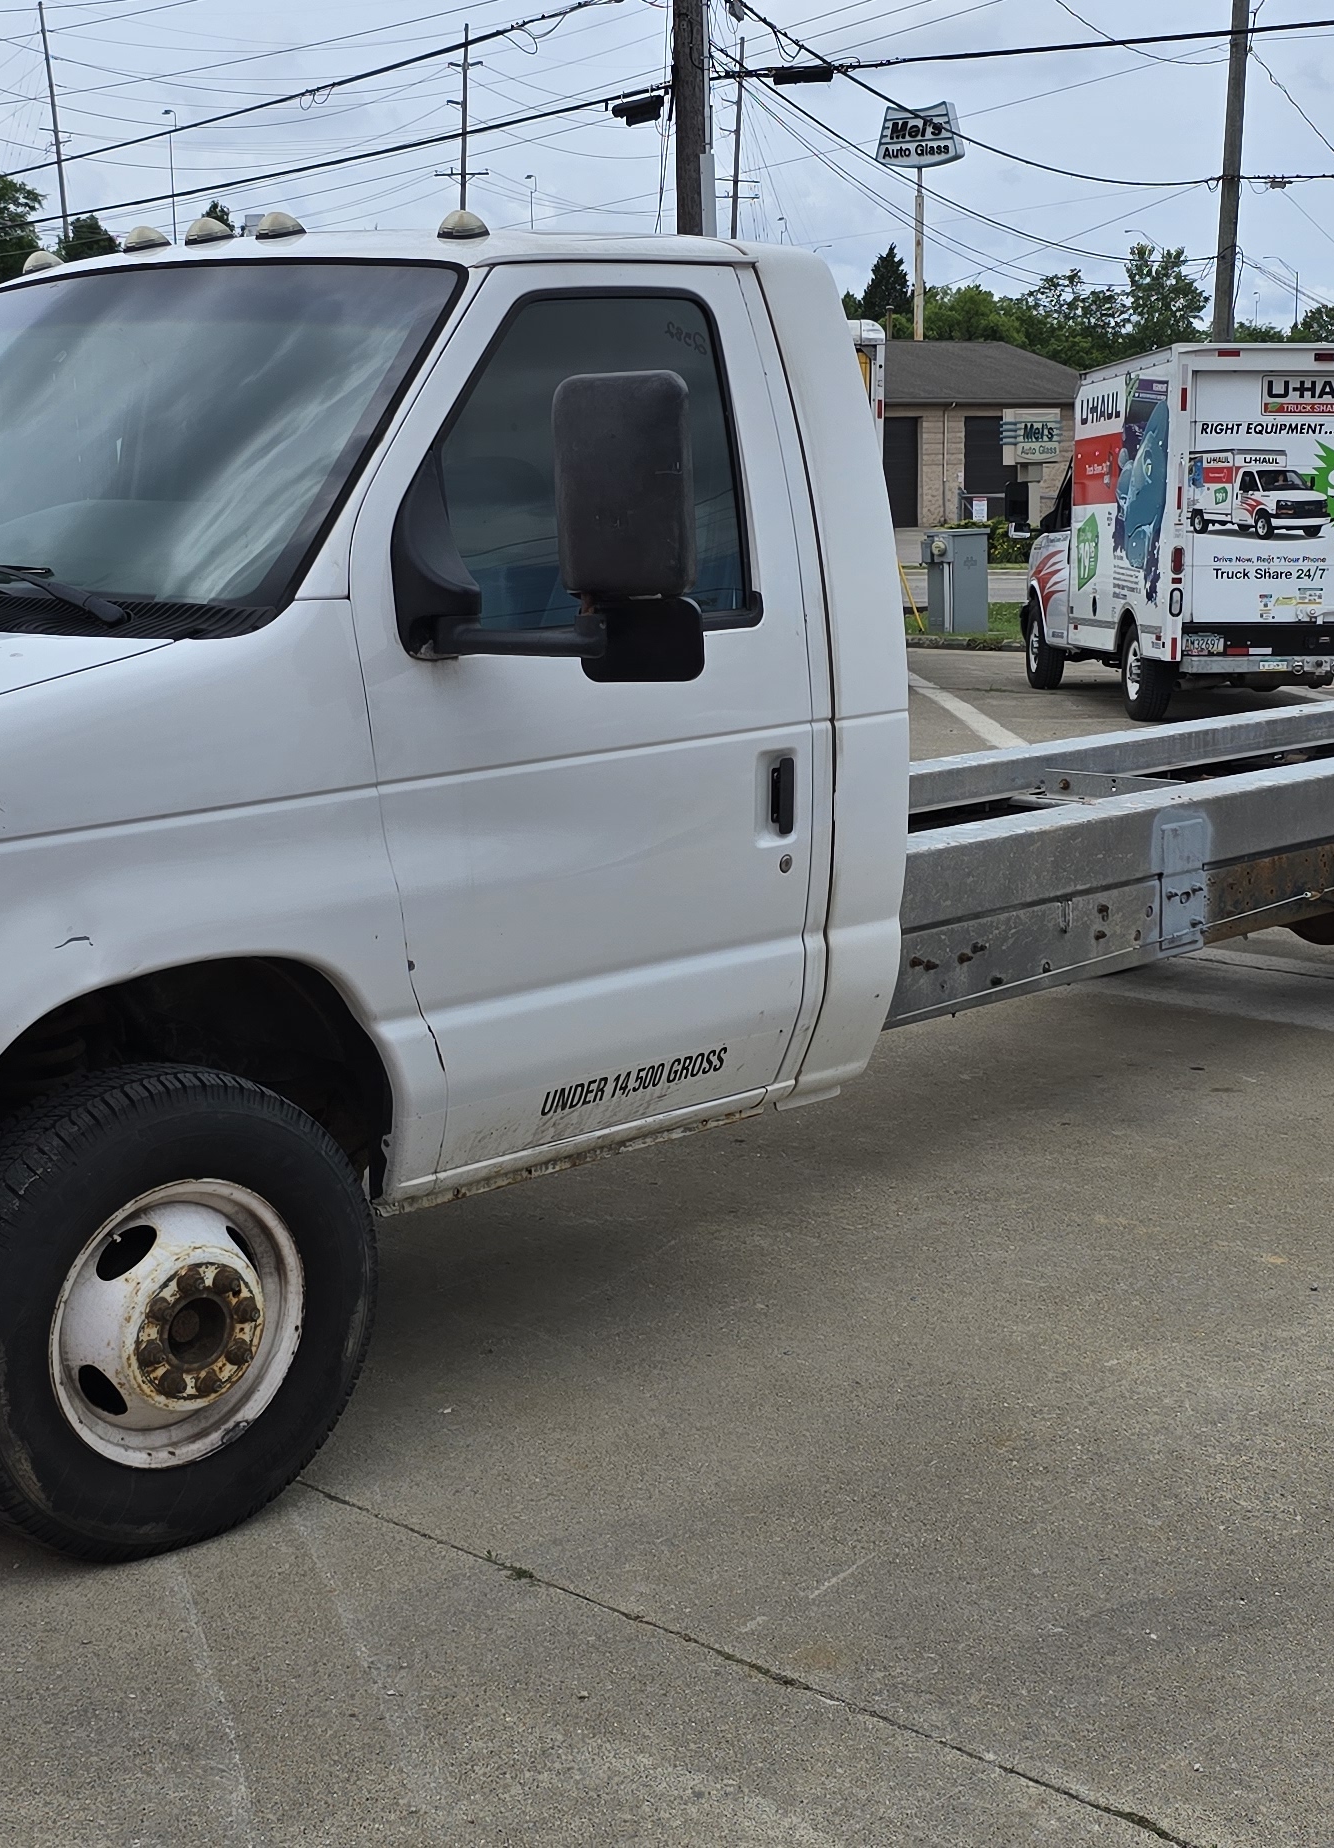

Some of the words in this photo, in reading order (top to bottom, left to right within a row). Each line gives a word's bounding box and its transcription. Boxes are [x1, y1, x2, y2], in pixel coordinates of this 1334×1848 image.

[889, 119, 943, 140] Mel's
[882, 146, 911, 159] Auto
[914, 143, 950, 156] Glass
[1080, 390, 1121, 426] U-HAUL
[1283, 404, 1312, 413] TRUCK
[1022, 422, 1055, 442] Mel's
[1200, 422, 1242, 435] RIGHT
[1020, 445, 1037, 456] Auto
[1038, 444, 1057, 456] Glass
[1206, 456, 1230, 465] U-HAUL
[1243, 456, 1280, 465] U-HAUL
[1213, 555, 1234, 563] Drive
[1235, 555, 1255, 564] Now,
[1301, 555, 1327, 563] Phone
[1213, 568, 1250, 580] Truck
[1254, 567, 1293, 580] Share
[1296, 566, 1326, 581] 24/7
[540, 1076, 609, 1117] UNDER
[610, 1062, 666, 1098] 14,500
[666, 1046, 729, 1084] GROSS
